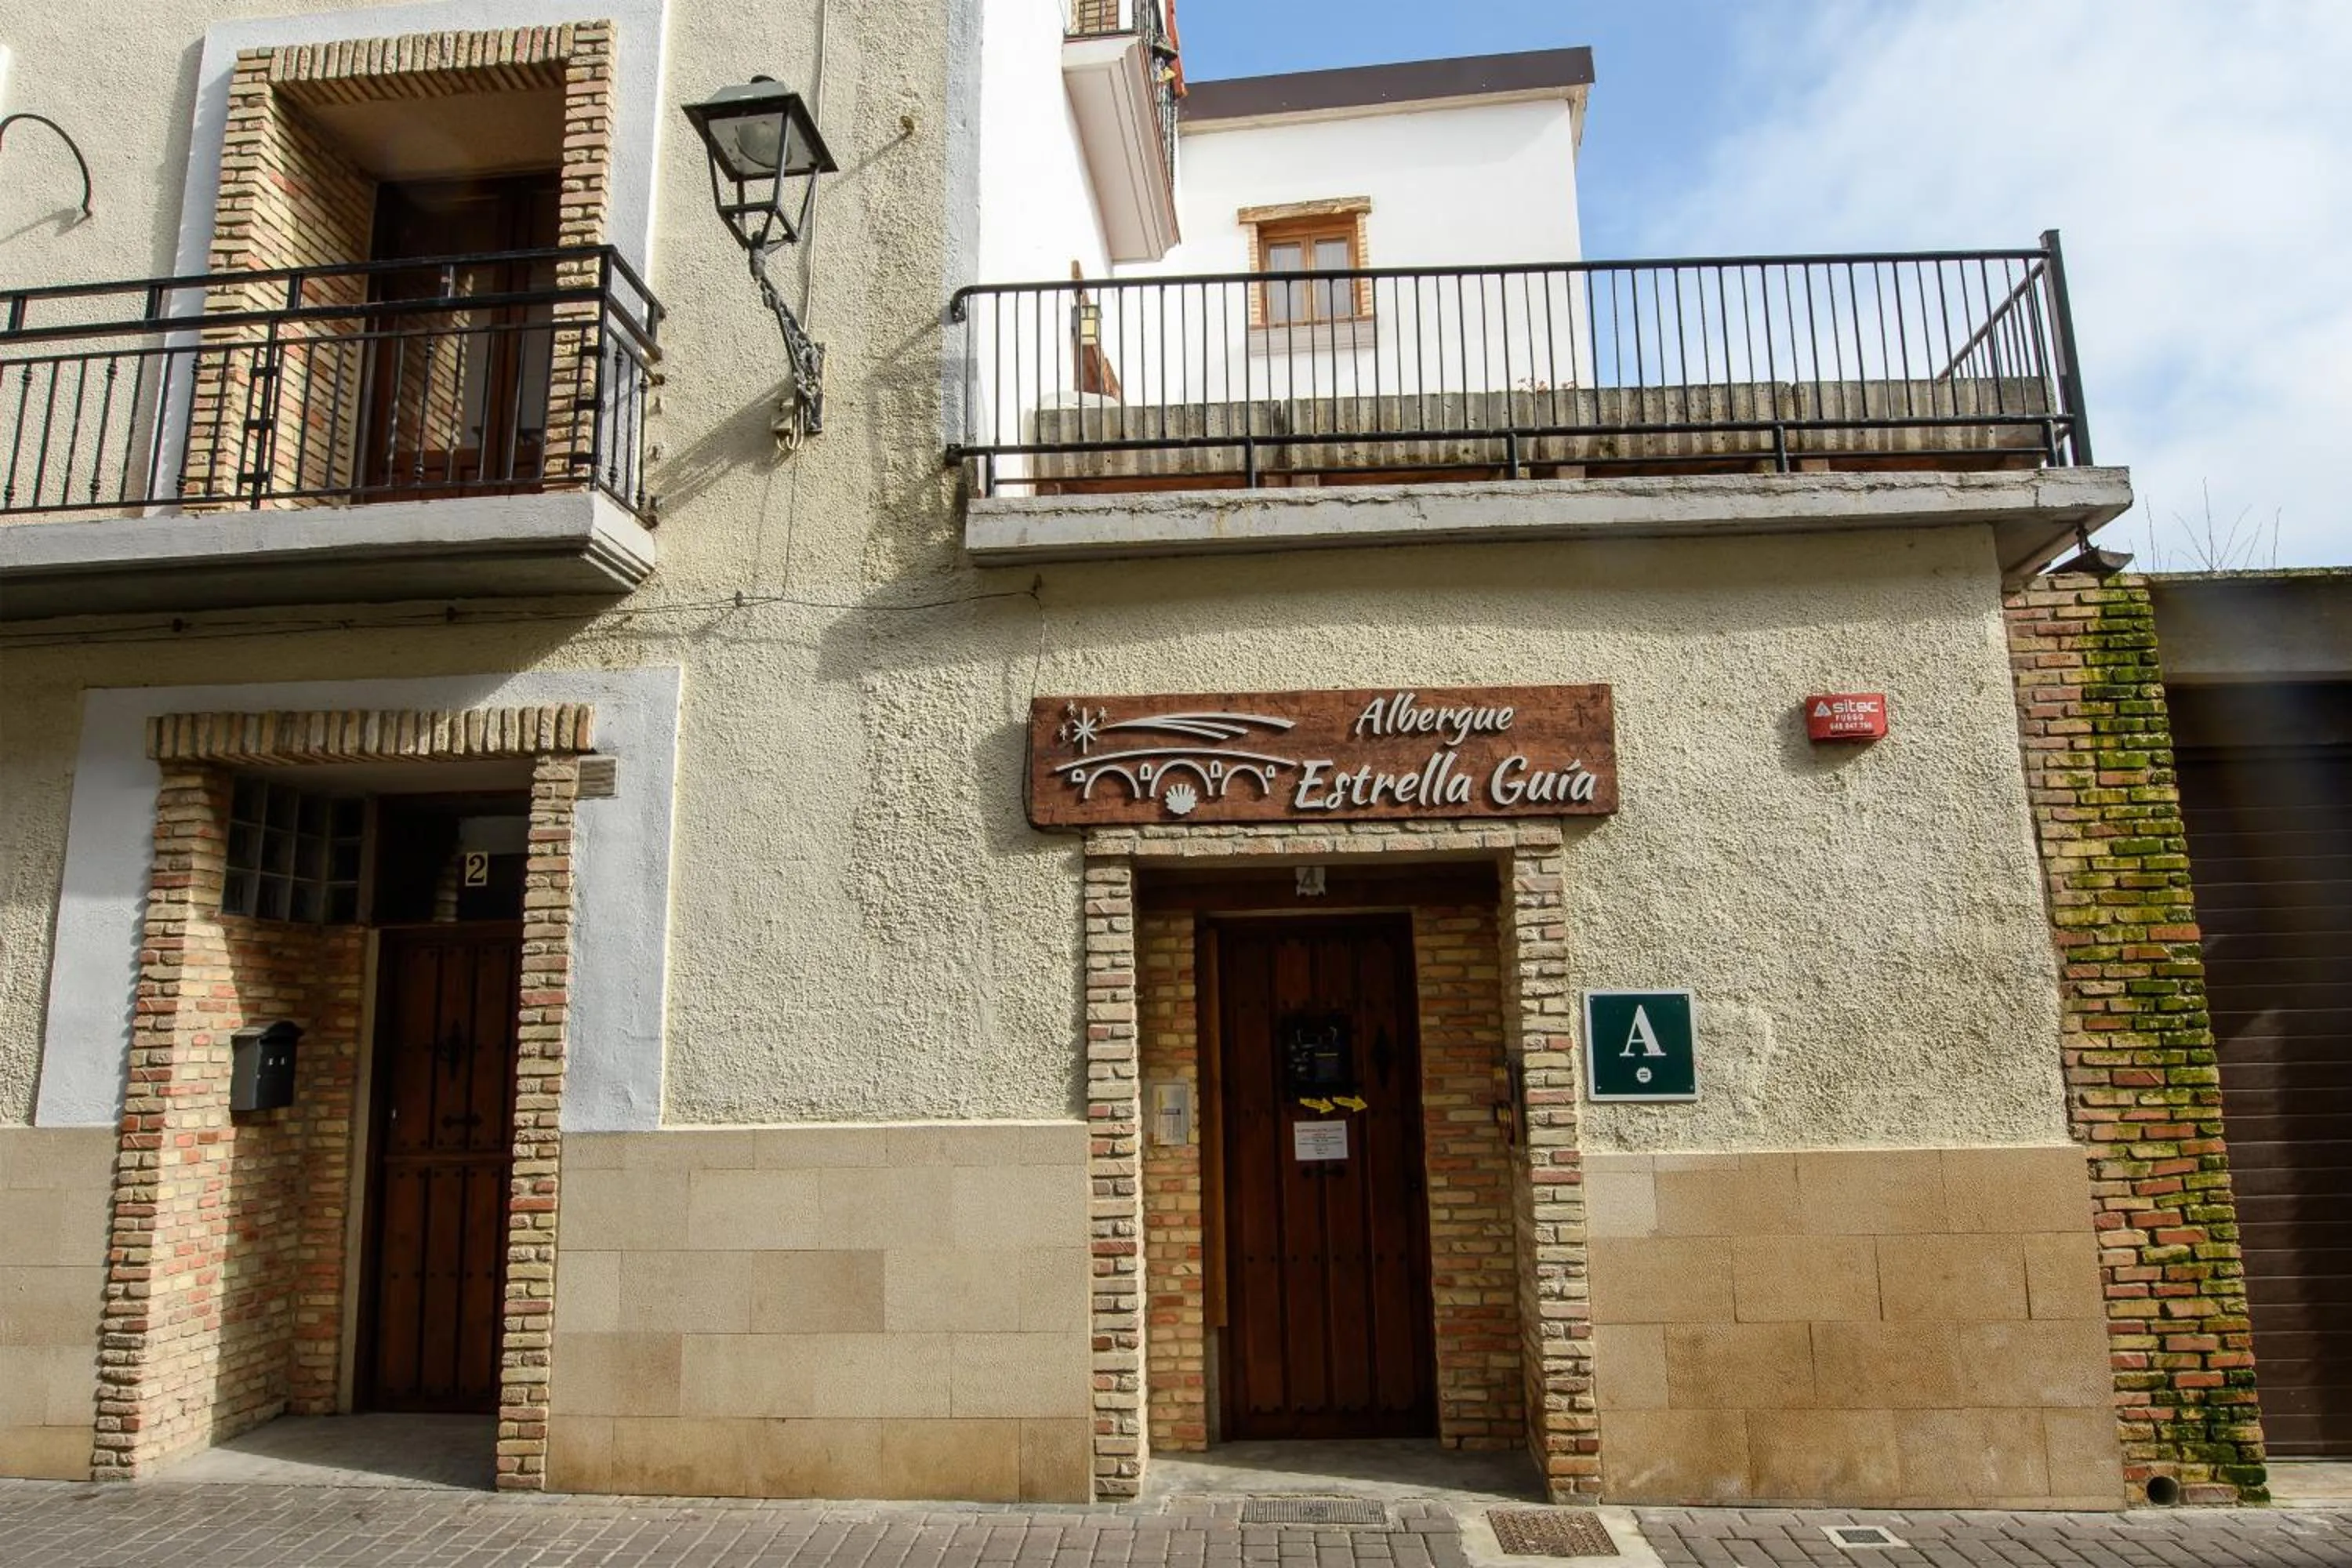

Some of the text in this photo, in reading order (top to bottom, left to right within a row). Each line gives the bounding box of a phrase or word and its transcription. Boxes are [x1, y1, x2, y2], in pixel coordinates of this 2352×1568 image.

[1355, 691, 1515, 746] Albergue
[1832, 699, 1879, 713] sitec
[1294, 750, 1597, 810] Estrella Guía
[468, 854, 485, 883] 2
[1619, 1004, 1667, 1057] A
